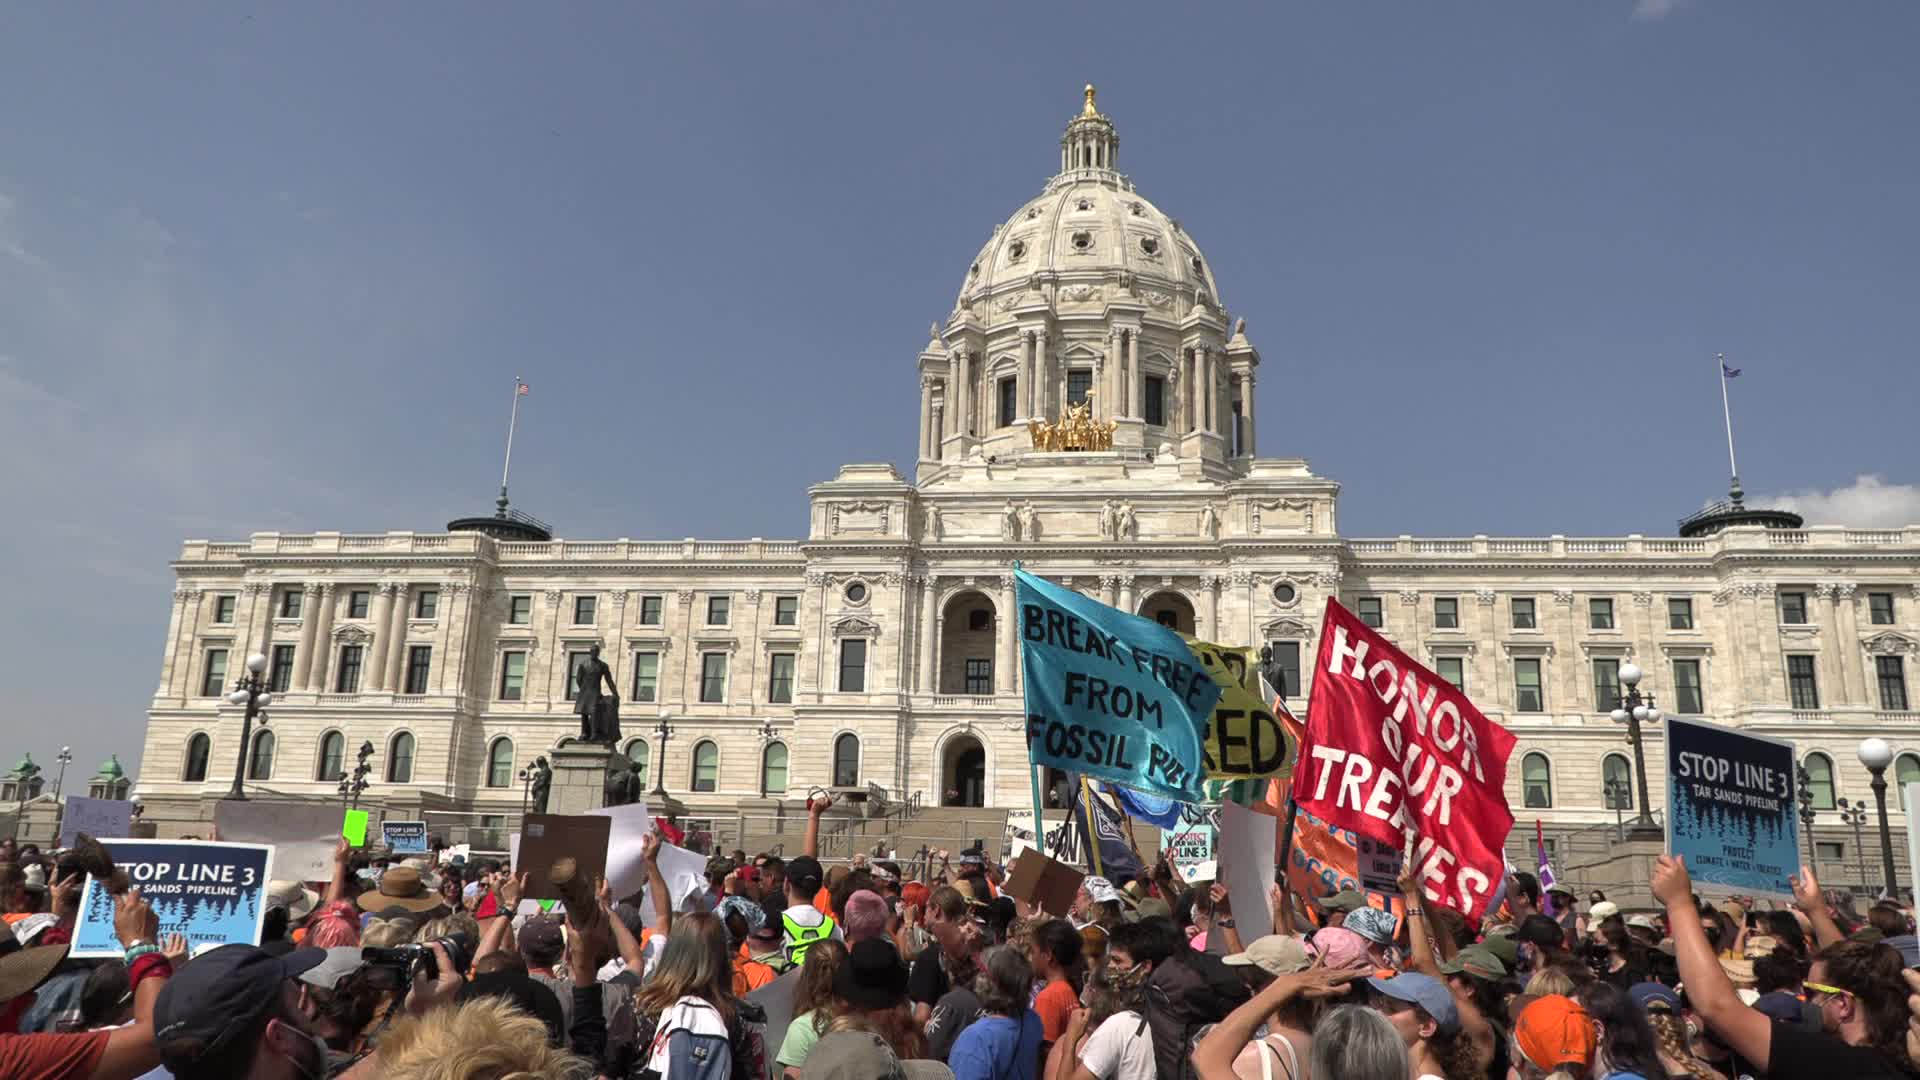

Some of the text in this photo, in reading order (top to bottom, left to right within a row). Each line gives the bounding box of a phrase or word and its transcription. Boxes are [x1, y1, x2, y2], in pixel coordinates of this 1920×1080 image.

[1023, 604, 1124, 665] BREAK
[1131, 647, 1211, 713] FREE
[1064, 671, 1163, 729] FROM
[1328, 624, 1485, 783] HONOR
[1027, 713, 1133, 771] FOSSIL
[1381, 716, 1463, 826] OUR
[1679, 751, 1789, 798] STOP LINE 3
[1692, 784, 1779, 811] TAR SANDS PIPELINE
[1175, 832, 1208, 840] PROTECT
[1311, 744, 1489, 915] TREAIES
[1180, 847, 1199, 858] LINE
[1201, 847, 1208, 858] 3
[1696, 855, 1724, 868] CLIMATE
[1722, 845, 1754, 860] PROTECT
[114, 862, 256, 886] TOP LINE 3
[143, 884, 183, 894] SANDS
[186, 884, 238, 896] PIPELINE
[158, 923, 190, 931] OTECT
[190, 932, 228, 942] TREATIES
